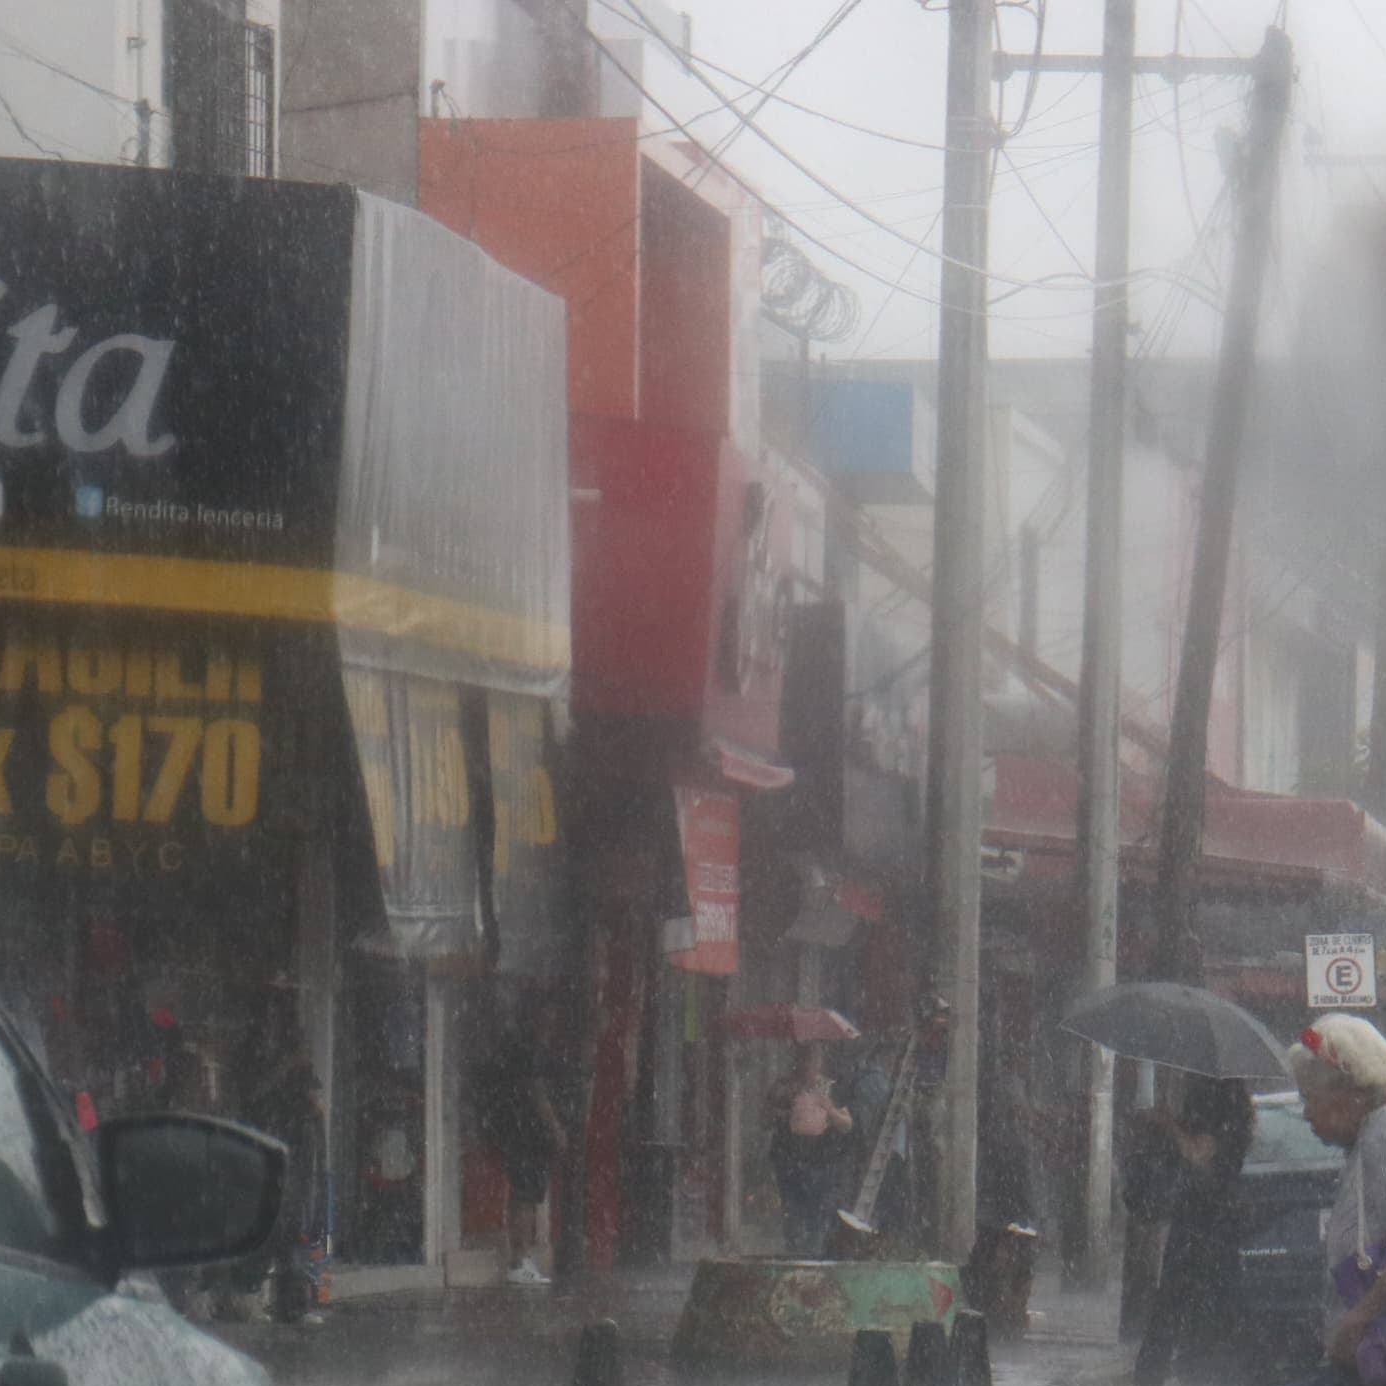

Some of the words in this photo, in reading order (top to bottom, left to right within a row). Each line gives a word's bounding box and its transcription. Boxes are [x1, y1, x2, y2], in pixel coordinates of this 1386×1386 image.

[46, 704, 262, 827] $170
[56, 838, 80, 866] A
[1335, 965, 1353, 987] E
